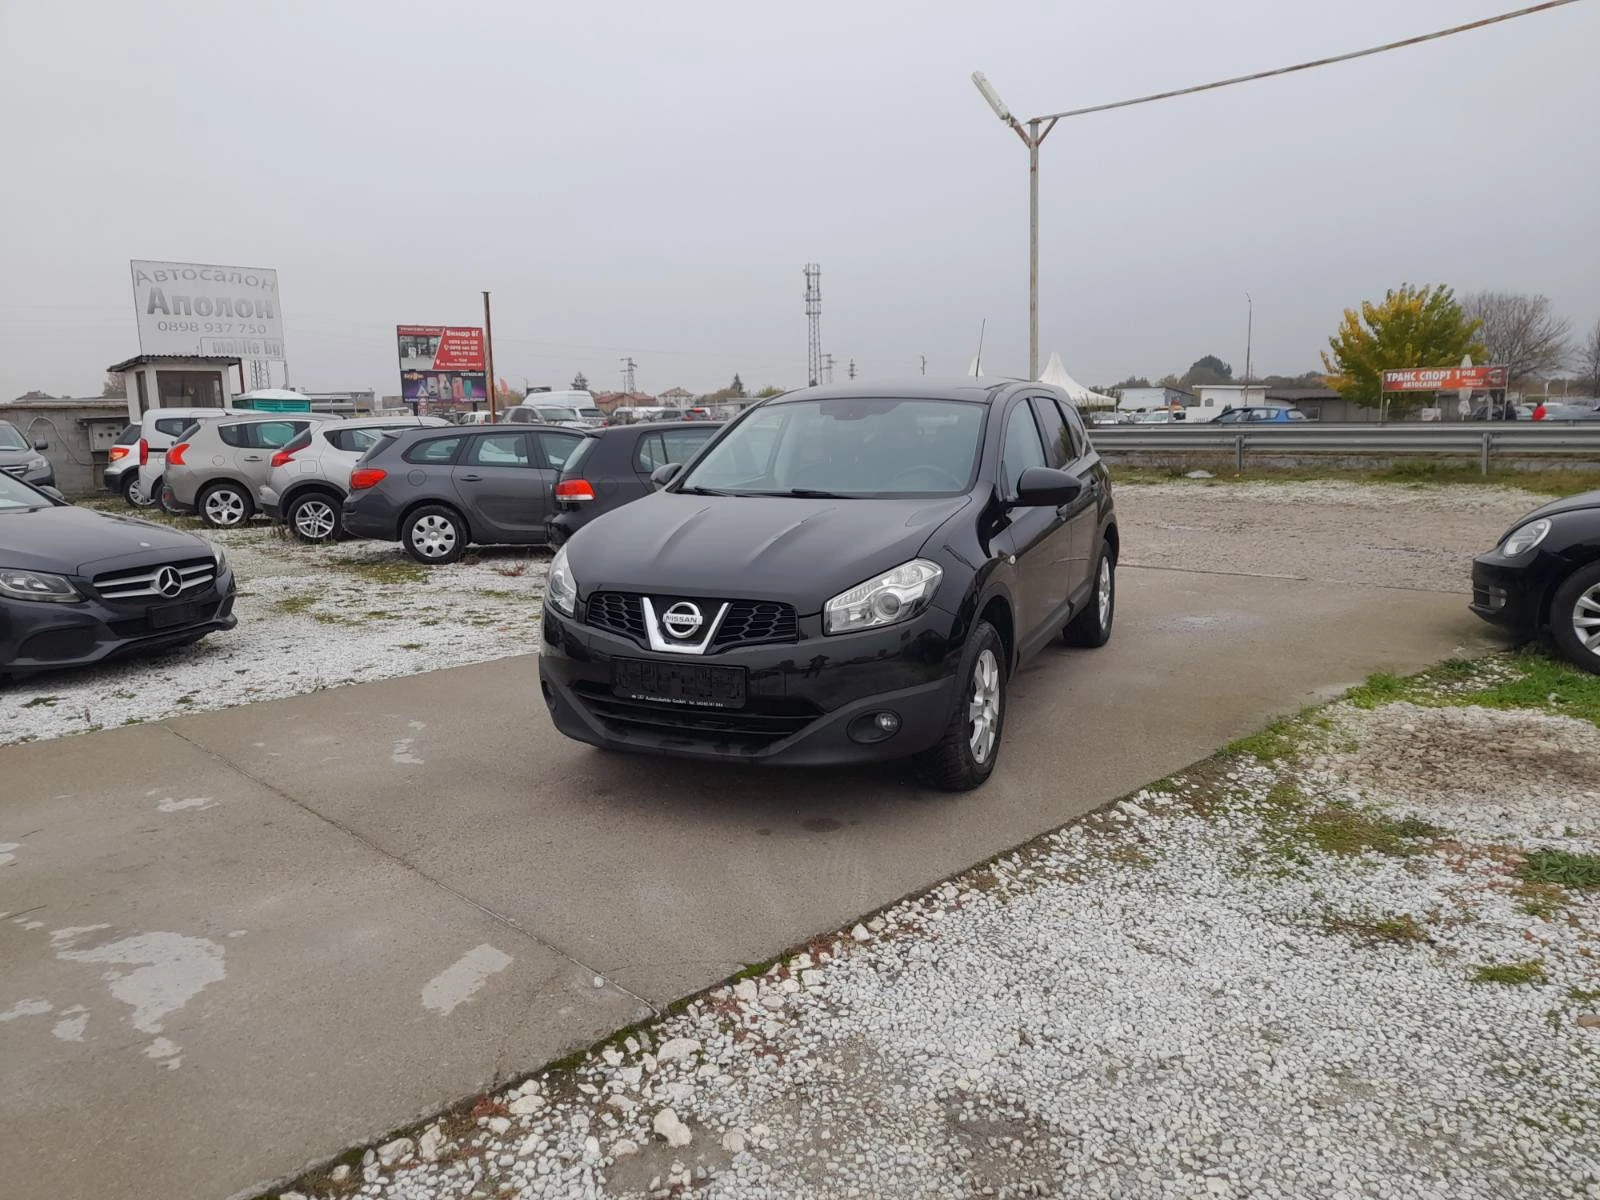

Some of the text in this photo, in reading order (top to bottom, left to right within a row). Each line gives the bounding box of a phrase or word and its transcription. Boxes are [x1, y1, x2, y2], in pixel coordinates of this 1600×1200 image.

[135, 268, 276, 292] Автосалон
[147, 286, 274, 319] Аполон
[158, 320, 267, 335] 0898 937 750
[1386, 373, 1417, 382] ТРАНС
[1419, 370, 1452, 381] СПОРТ
[665, 615, 698, 623] NISSAN
